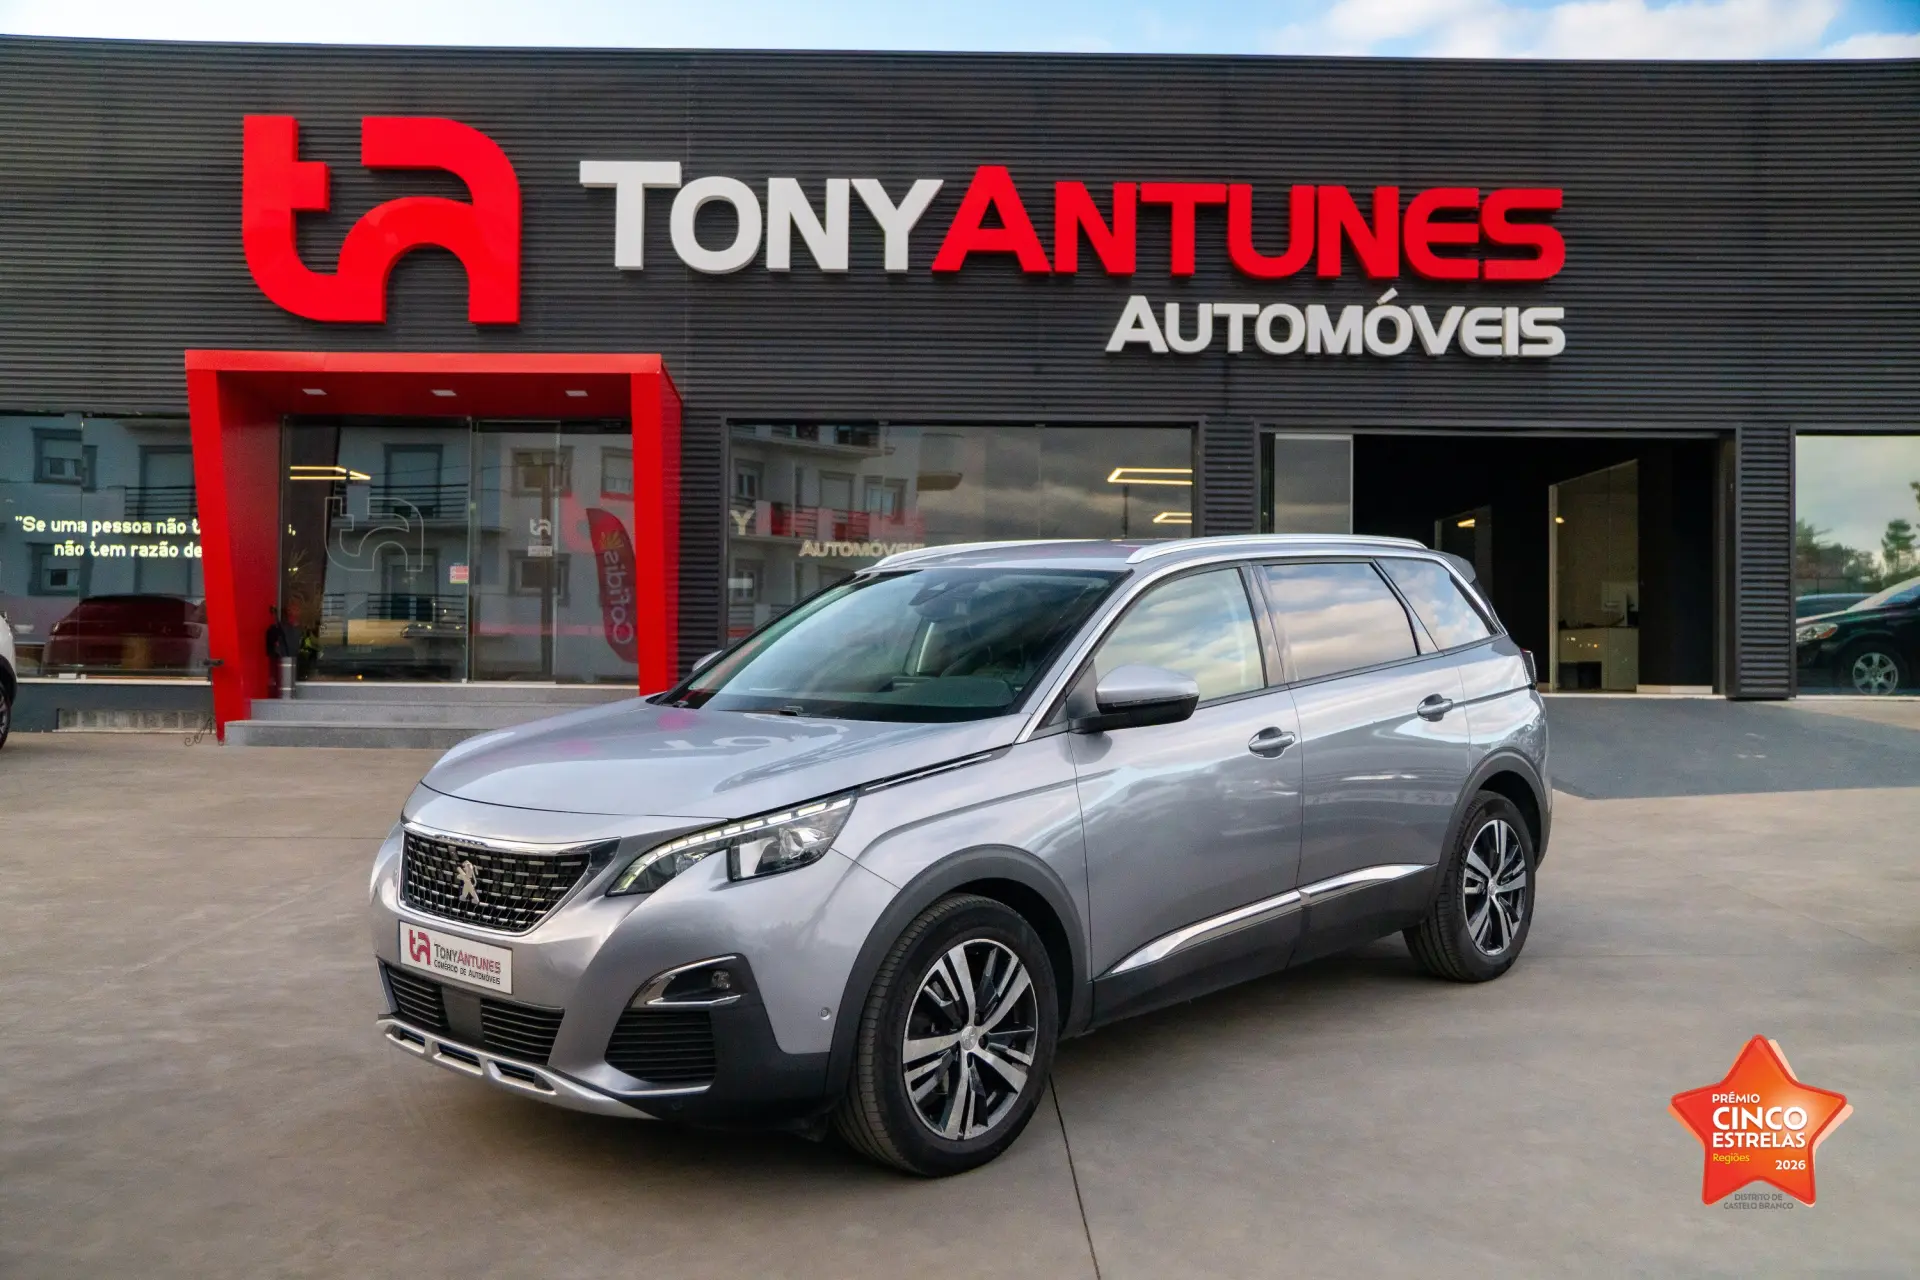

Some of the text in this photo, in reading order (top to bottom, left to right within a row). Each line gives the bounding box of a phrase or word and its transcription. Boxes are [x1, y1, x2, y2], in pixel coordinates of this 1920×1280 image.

[1105, 288, 1566, 357] AUTOMÓVEIS
[51, 519, 88, 533] uma
[92, 519, 152, 537] pessoa
[156, 517, 187, 534] não
[54, 539, 84, 556] não
[89, 540, 126, 557] tem
[130, 541, 179, 557] razão
[459, 967, 467, 977] DE
